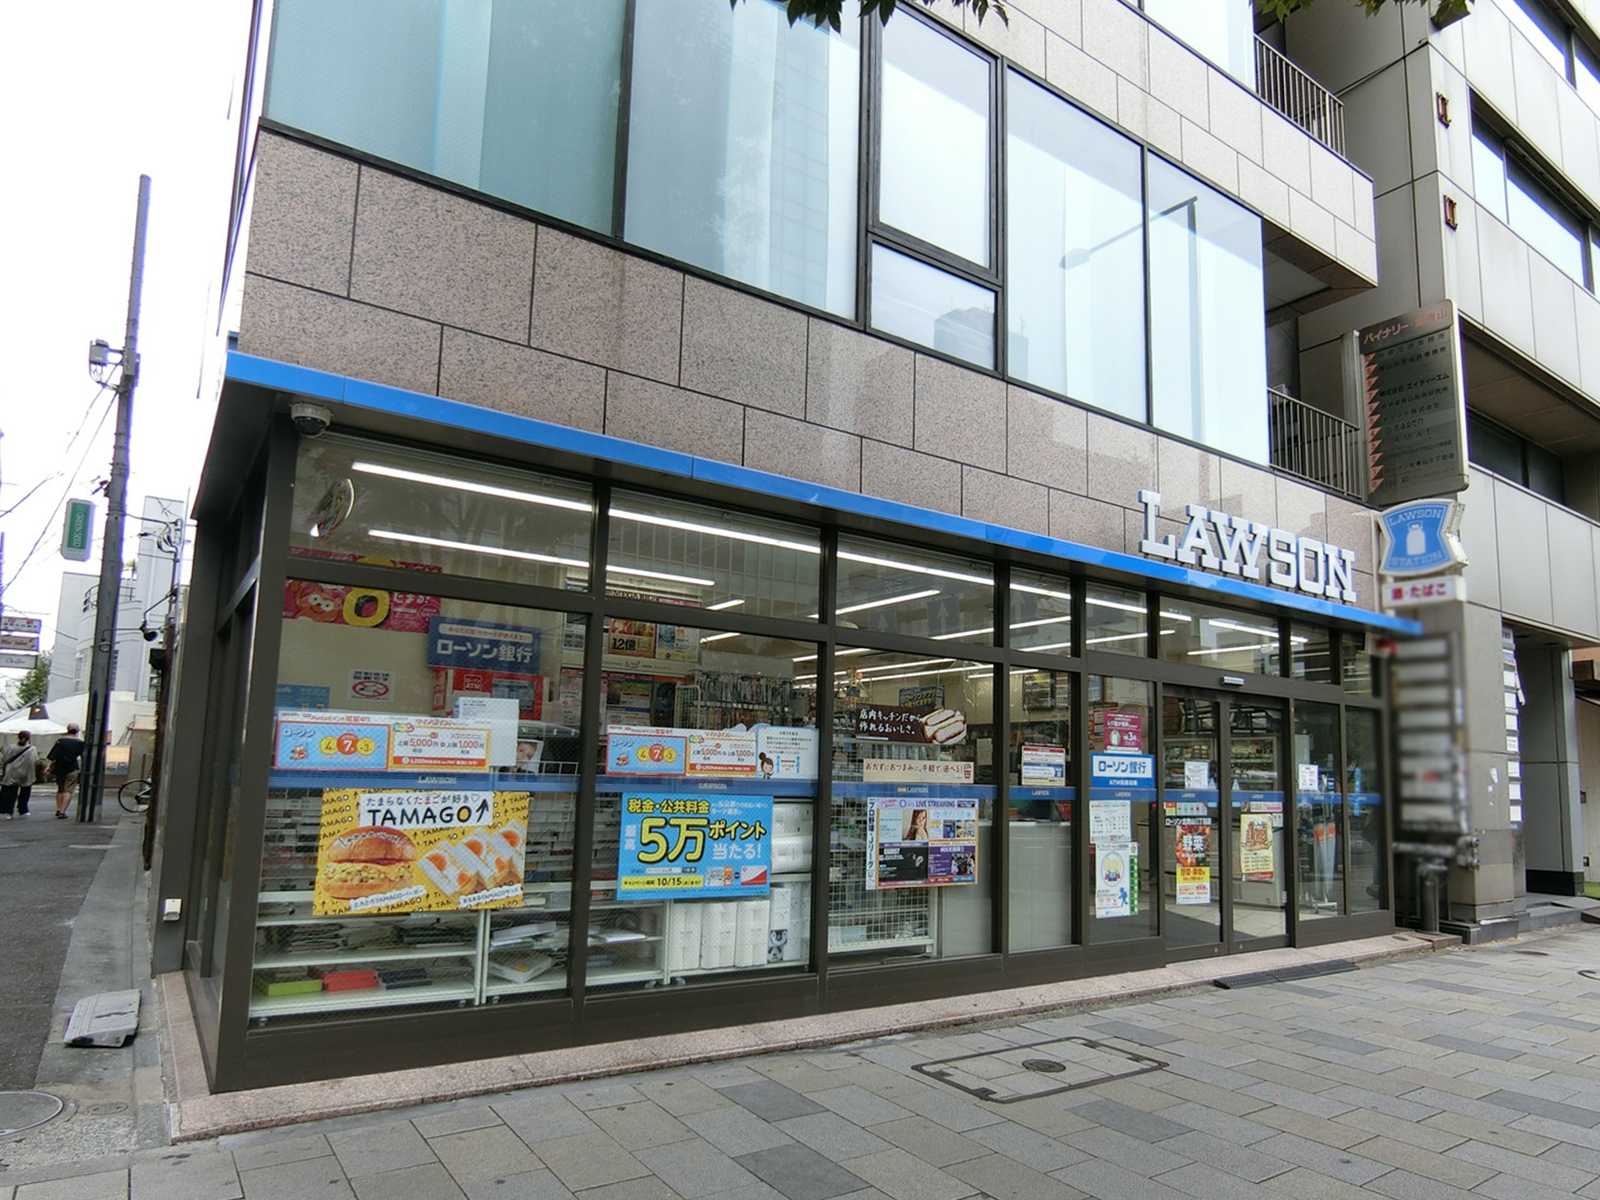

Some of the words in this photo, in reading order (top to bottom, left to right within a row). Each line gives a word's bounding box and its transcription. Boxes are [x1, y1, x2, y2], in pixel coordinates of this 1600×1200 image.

[1388, 508, 1442, 526] LAWSON
[1138, 489, 1357, 603] LAWSON
[1389, 550, 1443, 567] STATION
[436, 639, 533, 663] ローソン銀行
[859, 708, 921, 722] 店内キッチンだから
[859, 722, 915, 735] 作れるおいしさ。
[1098, 760, 1147, 774] ローソン銀行
[417, 776, 458, 784] LAWSON
[627, 798, 710, 815] 税金・公共料金
[367, 806, 472, 827] TAMAGO
[638, 817, 710, 864] 5万
[708, 821, 766, 840] ポイント
[1182, 834, 1205, 852] 野菜
[712, 843, 761, 860] 当たる!
